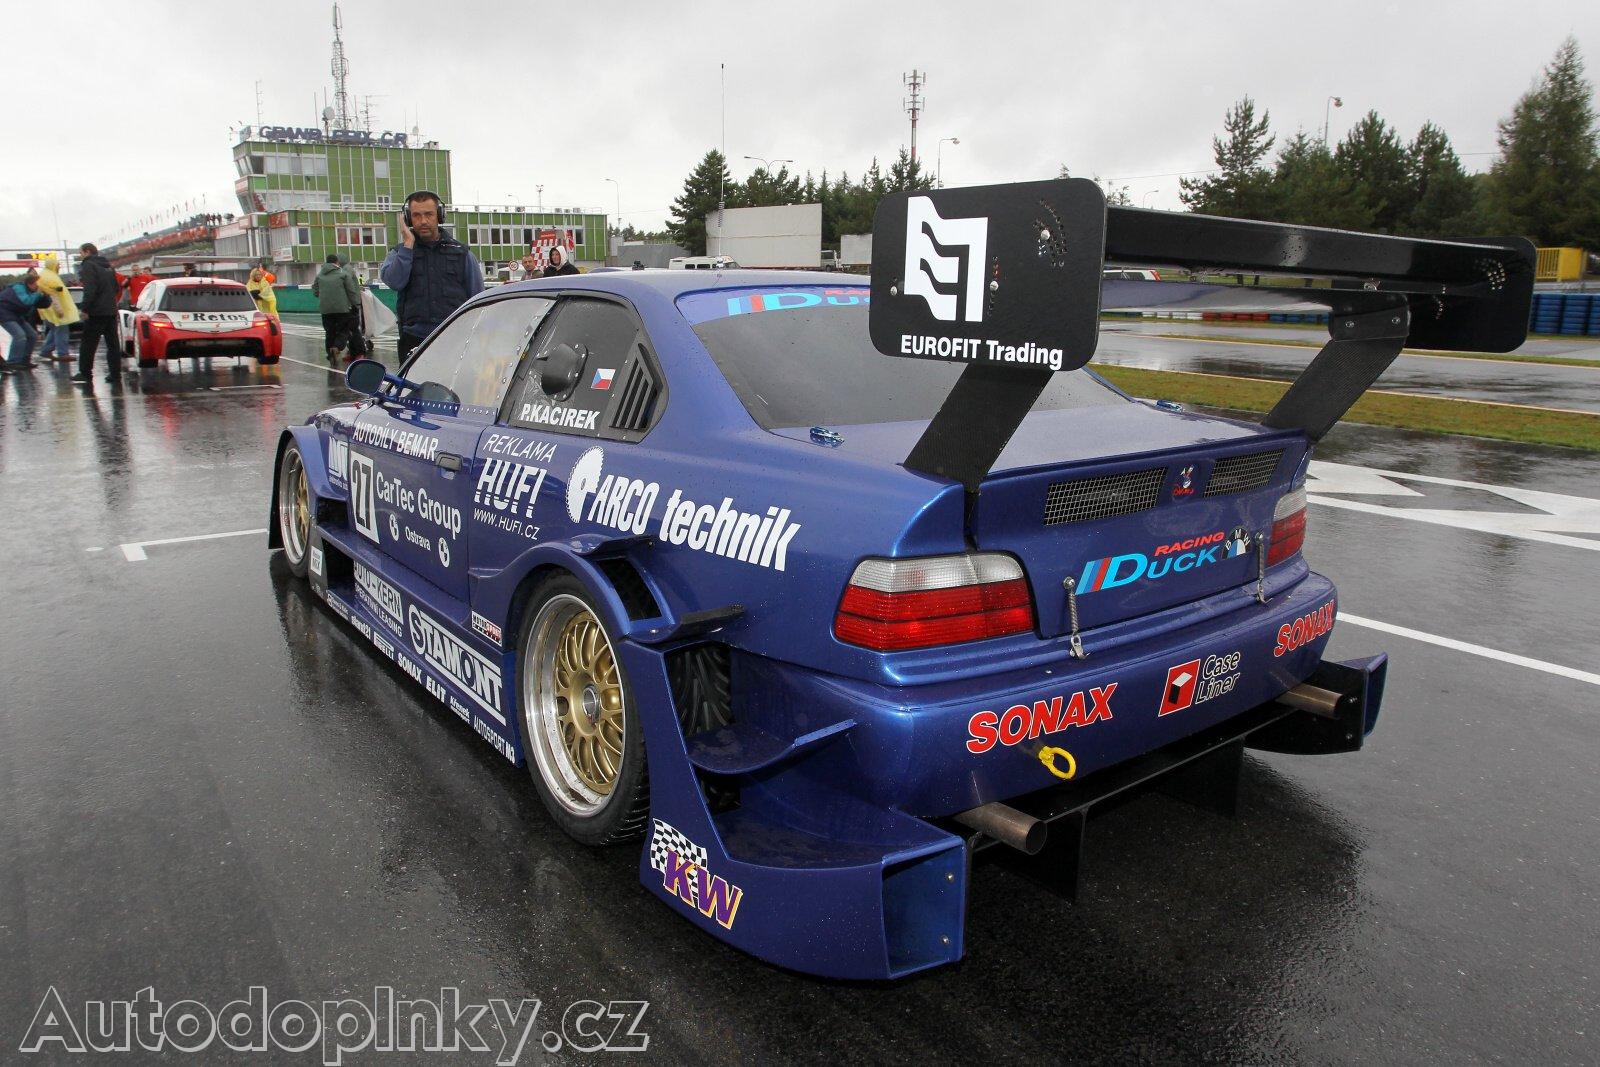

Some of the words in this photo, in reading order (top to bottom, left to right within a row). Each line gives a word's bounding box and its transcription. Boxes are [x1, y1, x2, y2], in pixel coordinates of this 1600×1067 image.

[259, 126, 323, 142] GRAND
[193, 312, 248, 323] Retos
[901, 334, 981, 359] EUROFIT
[986, 339, 1063, 371] Trading
[520, 403, 600, 430] P.KACIREK
[352, 422, 398, 450] AUTODÍLY
[396, 431, 439, 462] BEMAR
[483, 433, 558, 463] REKLAMA
[351, 459, 372, 531] 27
[376, 471, 415, 514] CarTec
[418, 488, 461, 540] Group
[474, 457, 548, 519] HUFI
[405, 526, 431, 551] Ostrava
[473, 508, 540, 540] WWW.HUFI.CZ
[659, 489, 802, 572] technik
[1154, 532, 1225, 557] RACING
[1274, 600, 1335, 657] SONAX
[398, 653, 422, 684] SONAX
[409, 604, 502, 712] STAMONT
[1202, 651, 1241, 678] Case
[426, 676, 446, 704] ELIT
[1195, 672, 1241, 705] Liner
[474, 715, 505, 755] AUTOSPORT
[966, 683, 1118, 753] SONAX
[663, 847, 743, 930] KW
